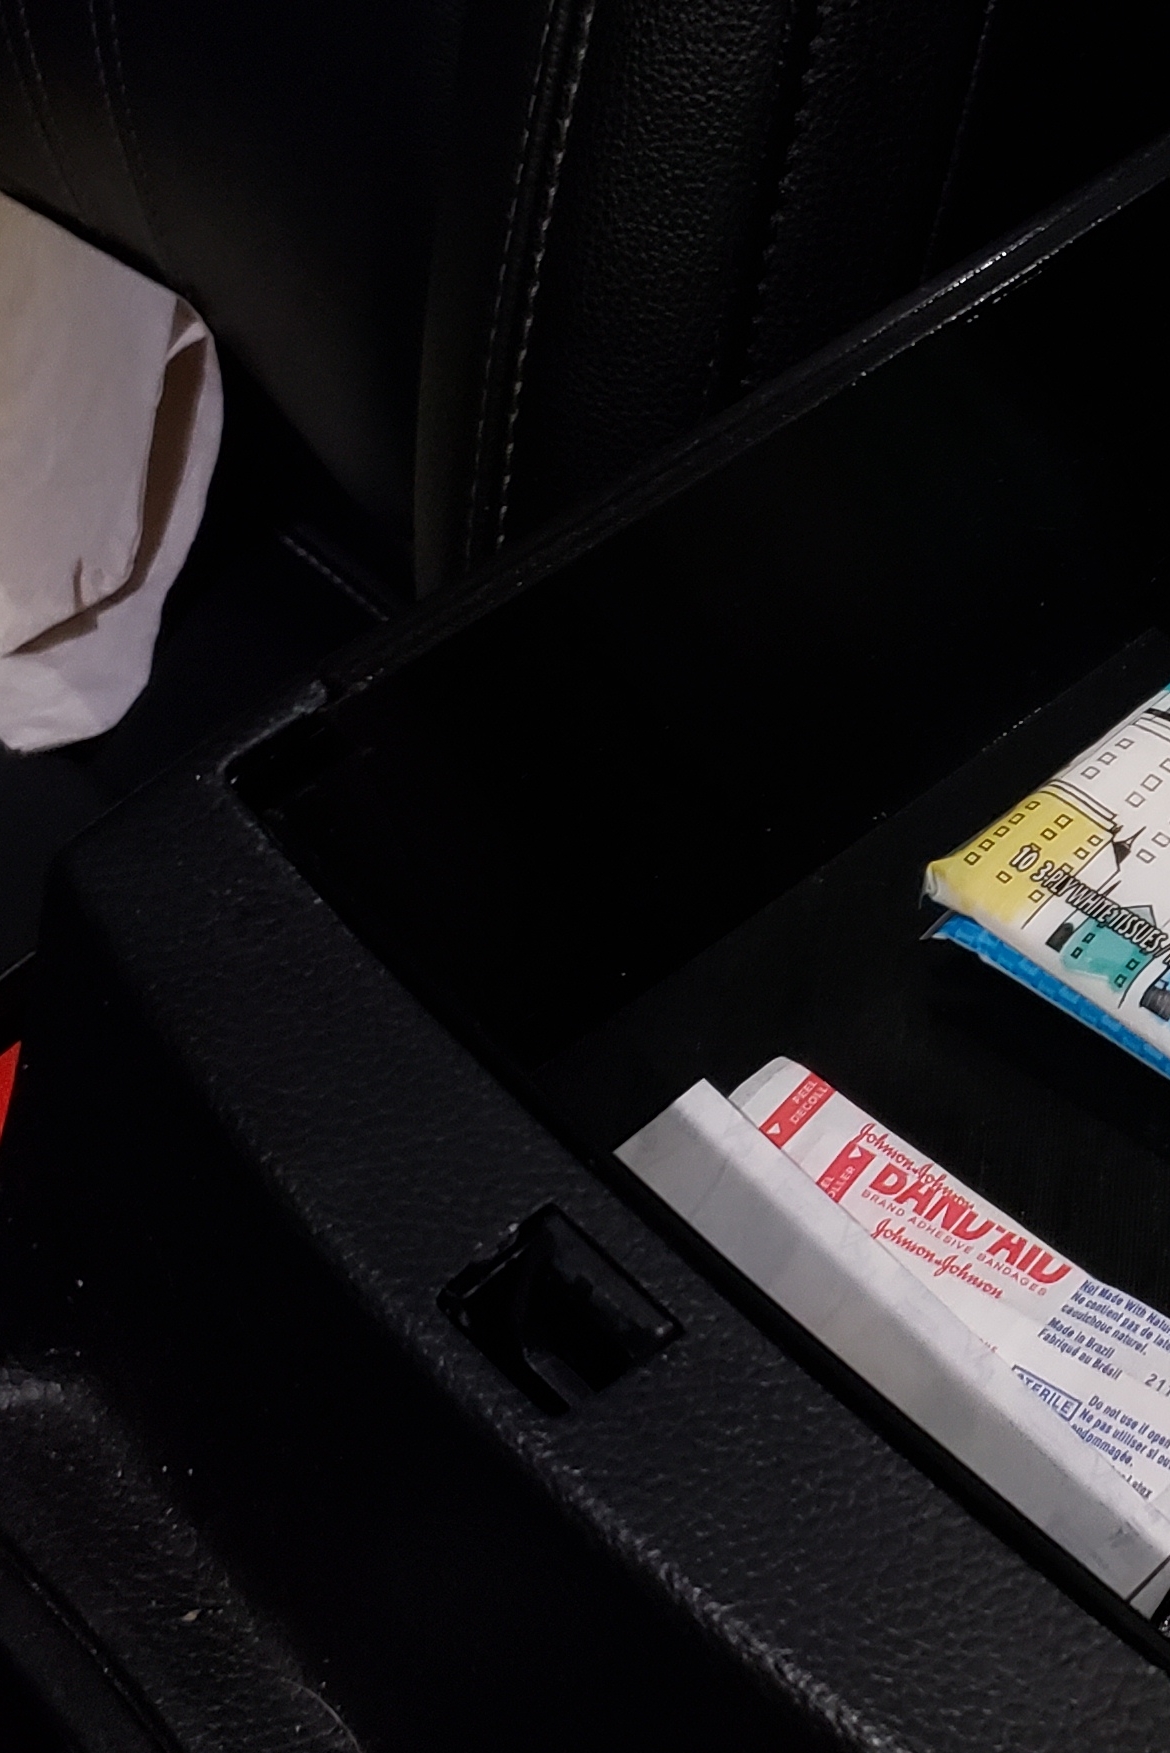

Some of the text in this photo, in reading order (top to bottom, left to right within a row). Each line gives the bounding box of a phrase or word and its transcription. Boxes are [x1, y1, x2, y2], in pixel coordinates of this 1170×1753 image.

[1009, 844, 1040, 872] 10
[1030, 860, 1077, 897] 3-PLY
[1065, 883, 1119, 926] WHITE
[1110, 907, 1168, 954] TISSUES
[792, 1080, 818, 1104] PEEL
[861, 1189, 1048, 1297] BRAND ADHESIVE BANDAGES
[1071, 1290, 1086, 1305] Ne
[1085, 1300, 1124, 1323] contient
[1120, 1317, 1140, 1334] pas
[1140, 1327, 1153, 1340] de
[1079, 1279, 1099, 1296] Not
[1098, 1288, 1124, 1306] Made
[1124, 1299, 1147, 1318] With
[1037, 1328, 1123, 1380] Fabriqué au Brésil
[1047, 1317, 1115, 1359] Made in Brazil
[1061, 1304, 1149, 1357] caoutchouc naturel.
[1079, 1408, 1094, 1423] Ne
[1092, 1418, 1112, 1434] pas
[1112, 1429, 1147, 1454] utiliser
[1146, 1448, 1159, 1460] si
[1088, 1395, 1104, 1410] Do
[1103, 1405, 1121, 1420] not
[1120, 1414, 1139, 1430] use
[1138, 1422, 1150, 1435] if
